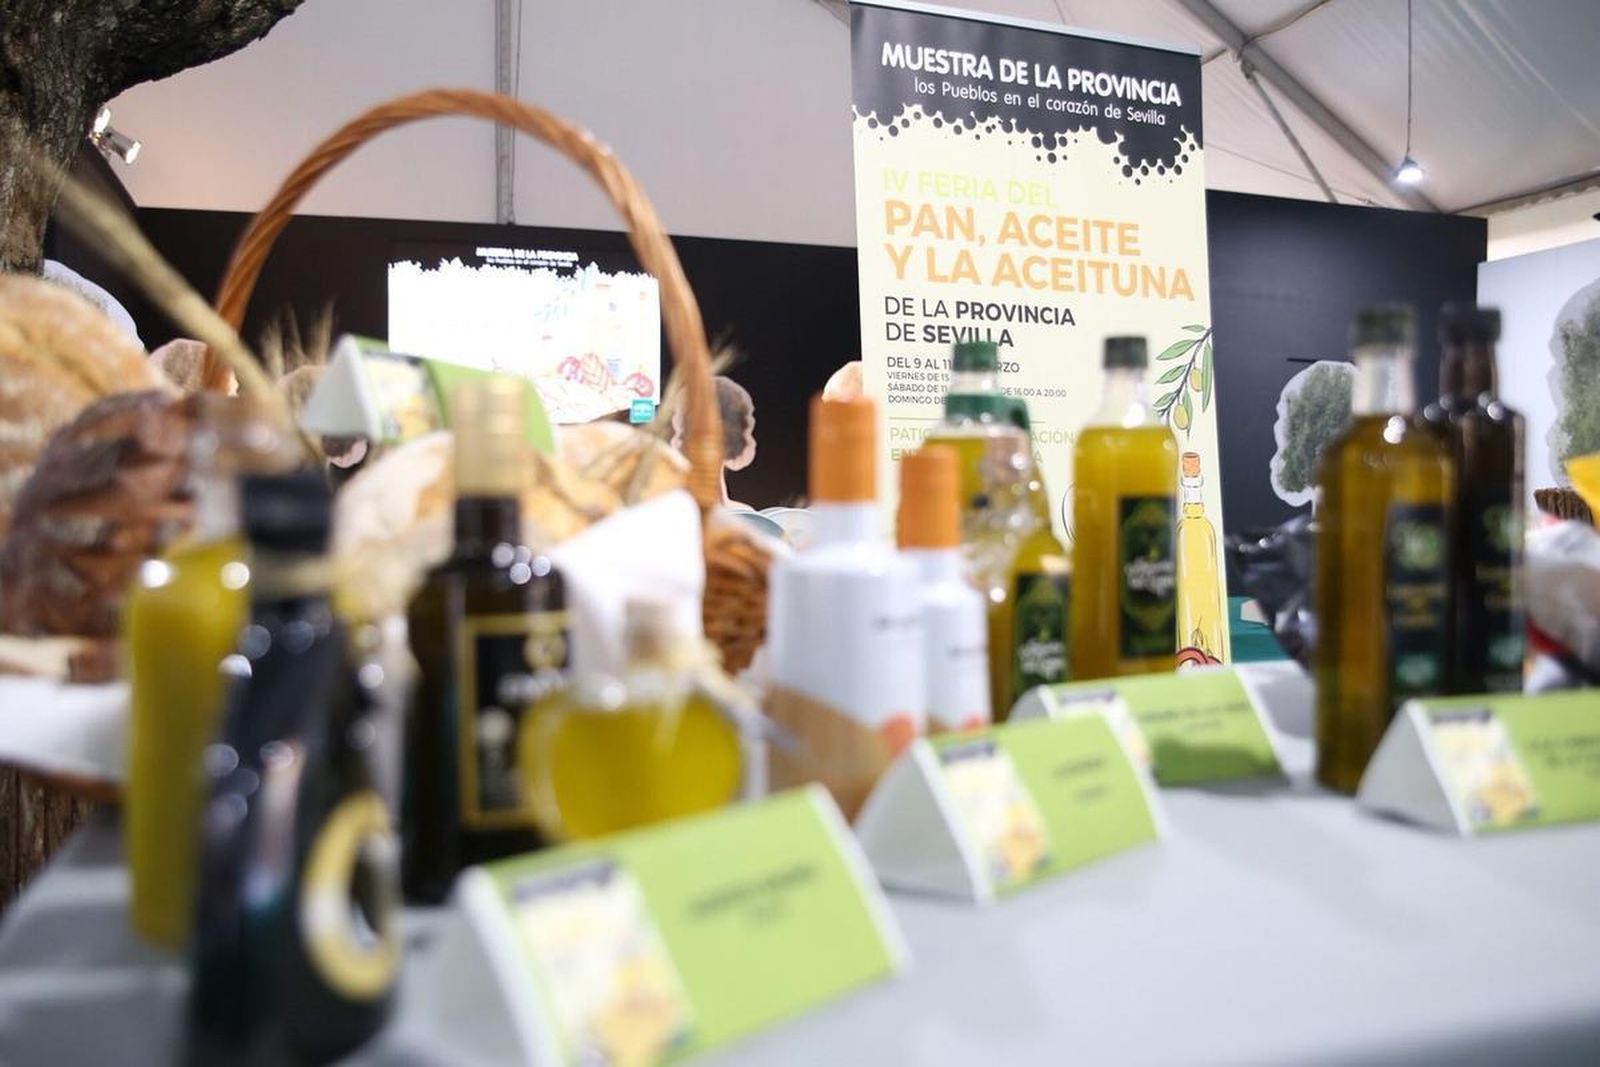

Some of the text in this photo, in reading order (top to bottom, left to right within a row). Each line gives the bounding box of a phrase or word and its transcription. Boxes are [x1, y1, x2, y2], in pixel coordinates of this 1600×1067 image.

[882, 42, 1181, 106] MUESTRA DE LA PROVINCIA
[915, 77, 1166, 126] los Pueblos en el corazón de Sevilla
[883, 168, 1057, 207] IV FERIA DEL
[885, 199, 1141, 257] PAN, ACEITE
[885, 243, 1195, 302] Y LA ACEITUNA
[885, 296, 1076, 326] DE LA PROVINCIA
[886, 322, 916, 342] DE
[887, 356, 911, 368] DEL
[914, 357, 922, 369] 9
[924, 358, 940, 370] AL
[942, 359, 953, 370] 11
[887, 371, 925, 381] VIERNES
[927, 372, 940, 382] DE
[888, 394, 933, 405] DOMINGO
[927, 384, 940, 393] DE
[1036, 388, 1042, 396] A
